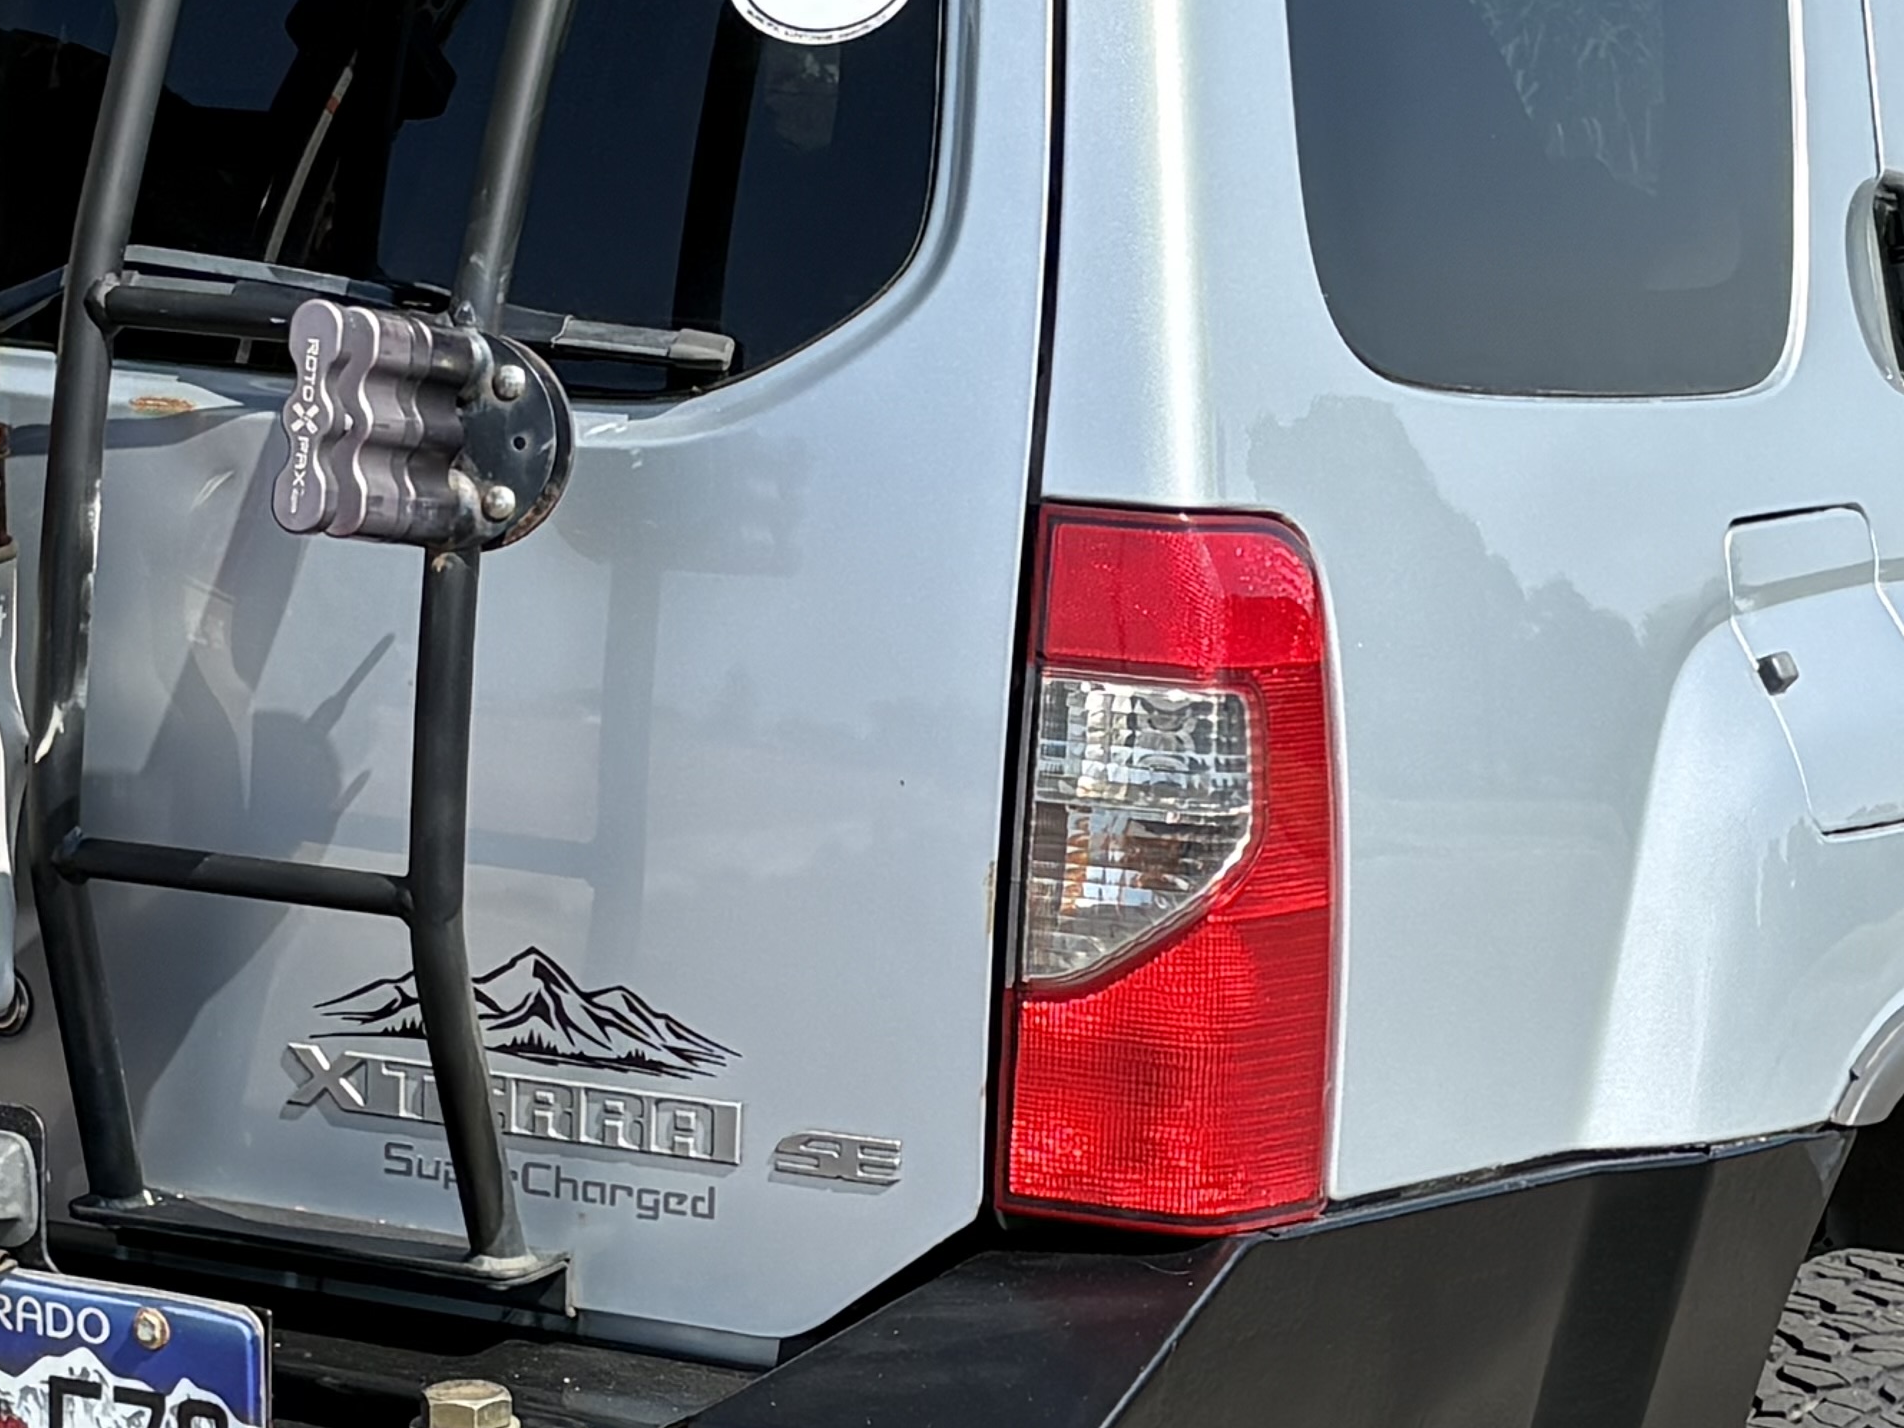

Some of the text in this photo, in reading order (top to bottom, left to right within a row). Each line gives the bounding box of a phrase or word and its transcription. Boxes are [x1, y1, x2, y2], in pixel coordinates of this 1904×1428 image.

[302, 338, 321, 403] ROTO
[291, 435, 310, 486] PAX
[287, 1042, 742, 1165] XTRRA
[382, 1141, 717, 1221] SupCharged
[774, 1129, 902, 1187] SE
